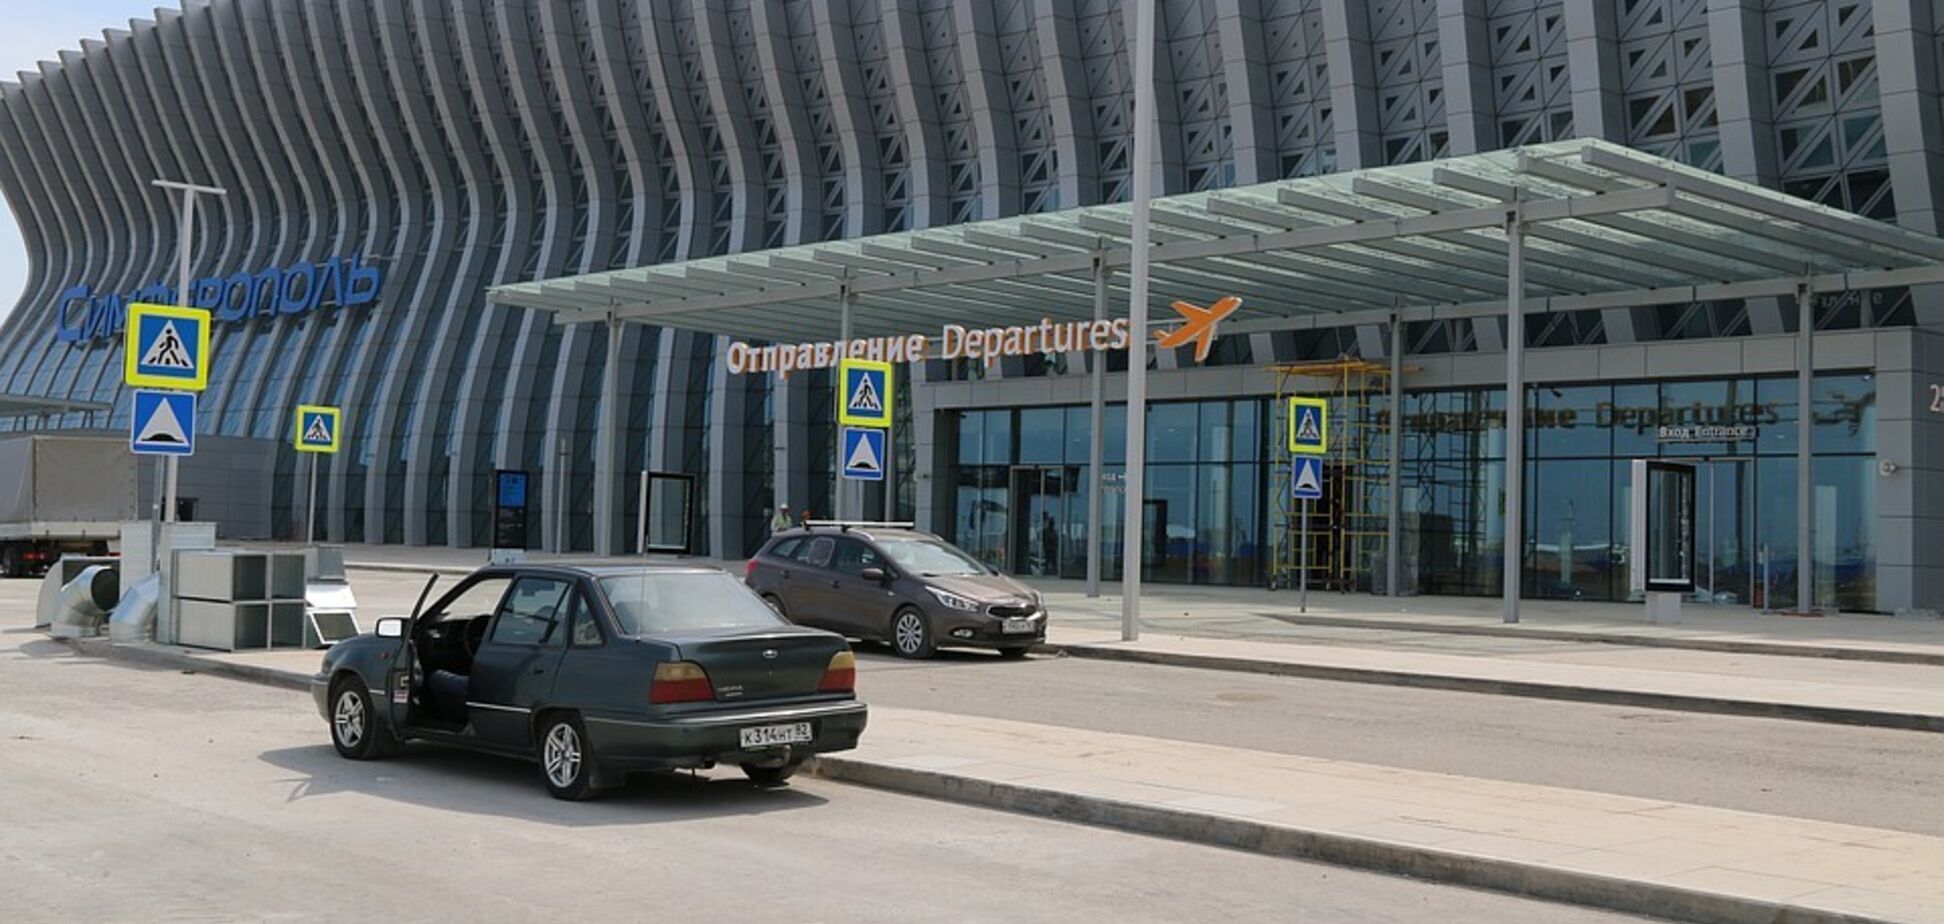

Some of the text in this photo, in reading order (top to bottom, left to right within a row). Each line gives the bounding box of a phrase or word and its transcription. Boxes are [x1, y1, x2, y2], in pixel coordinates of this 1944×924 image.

[726, 316, 1132, 380] Отправление Departures
[1659, 426, 1690, 438] Вход
